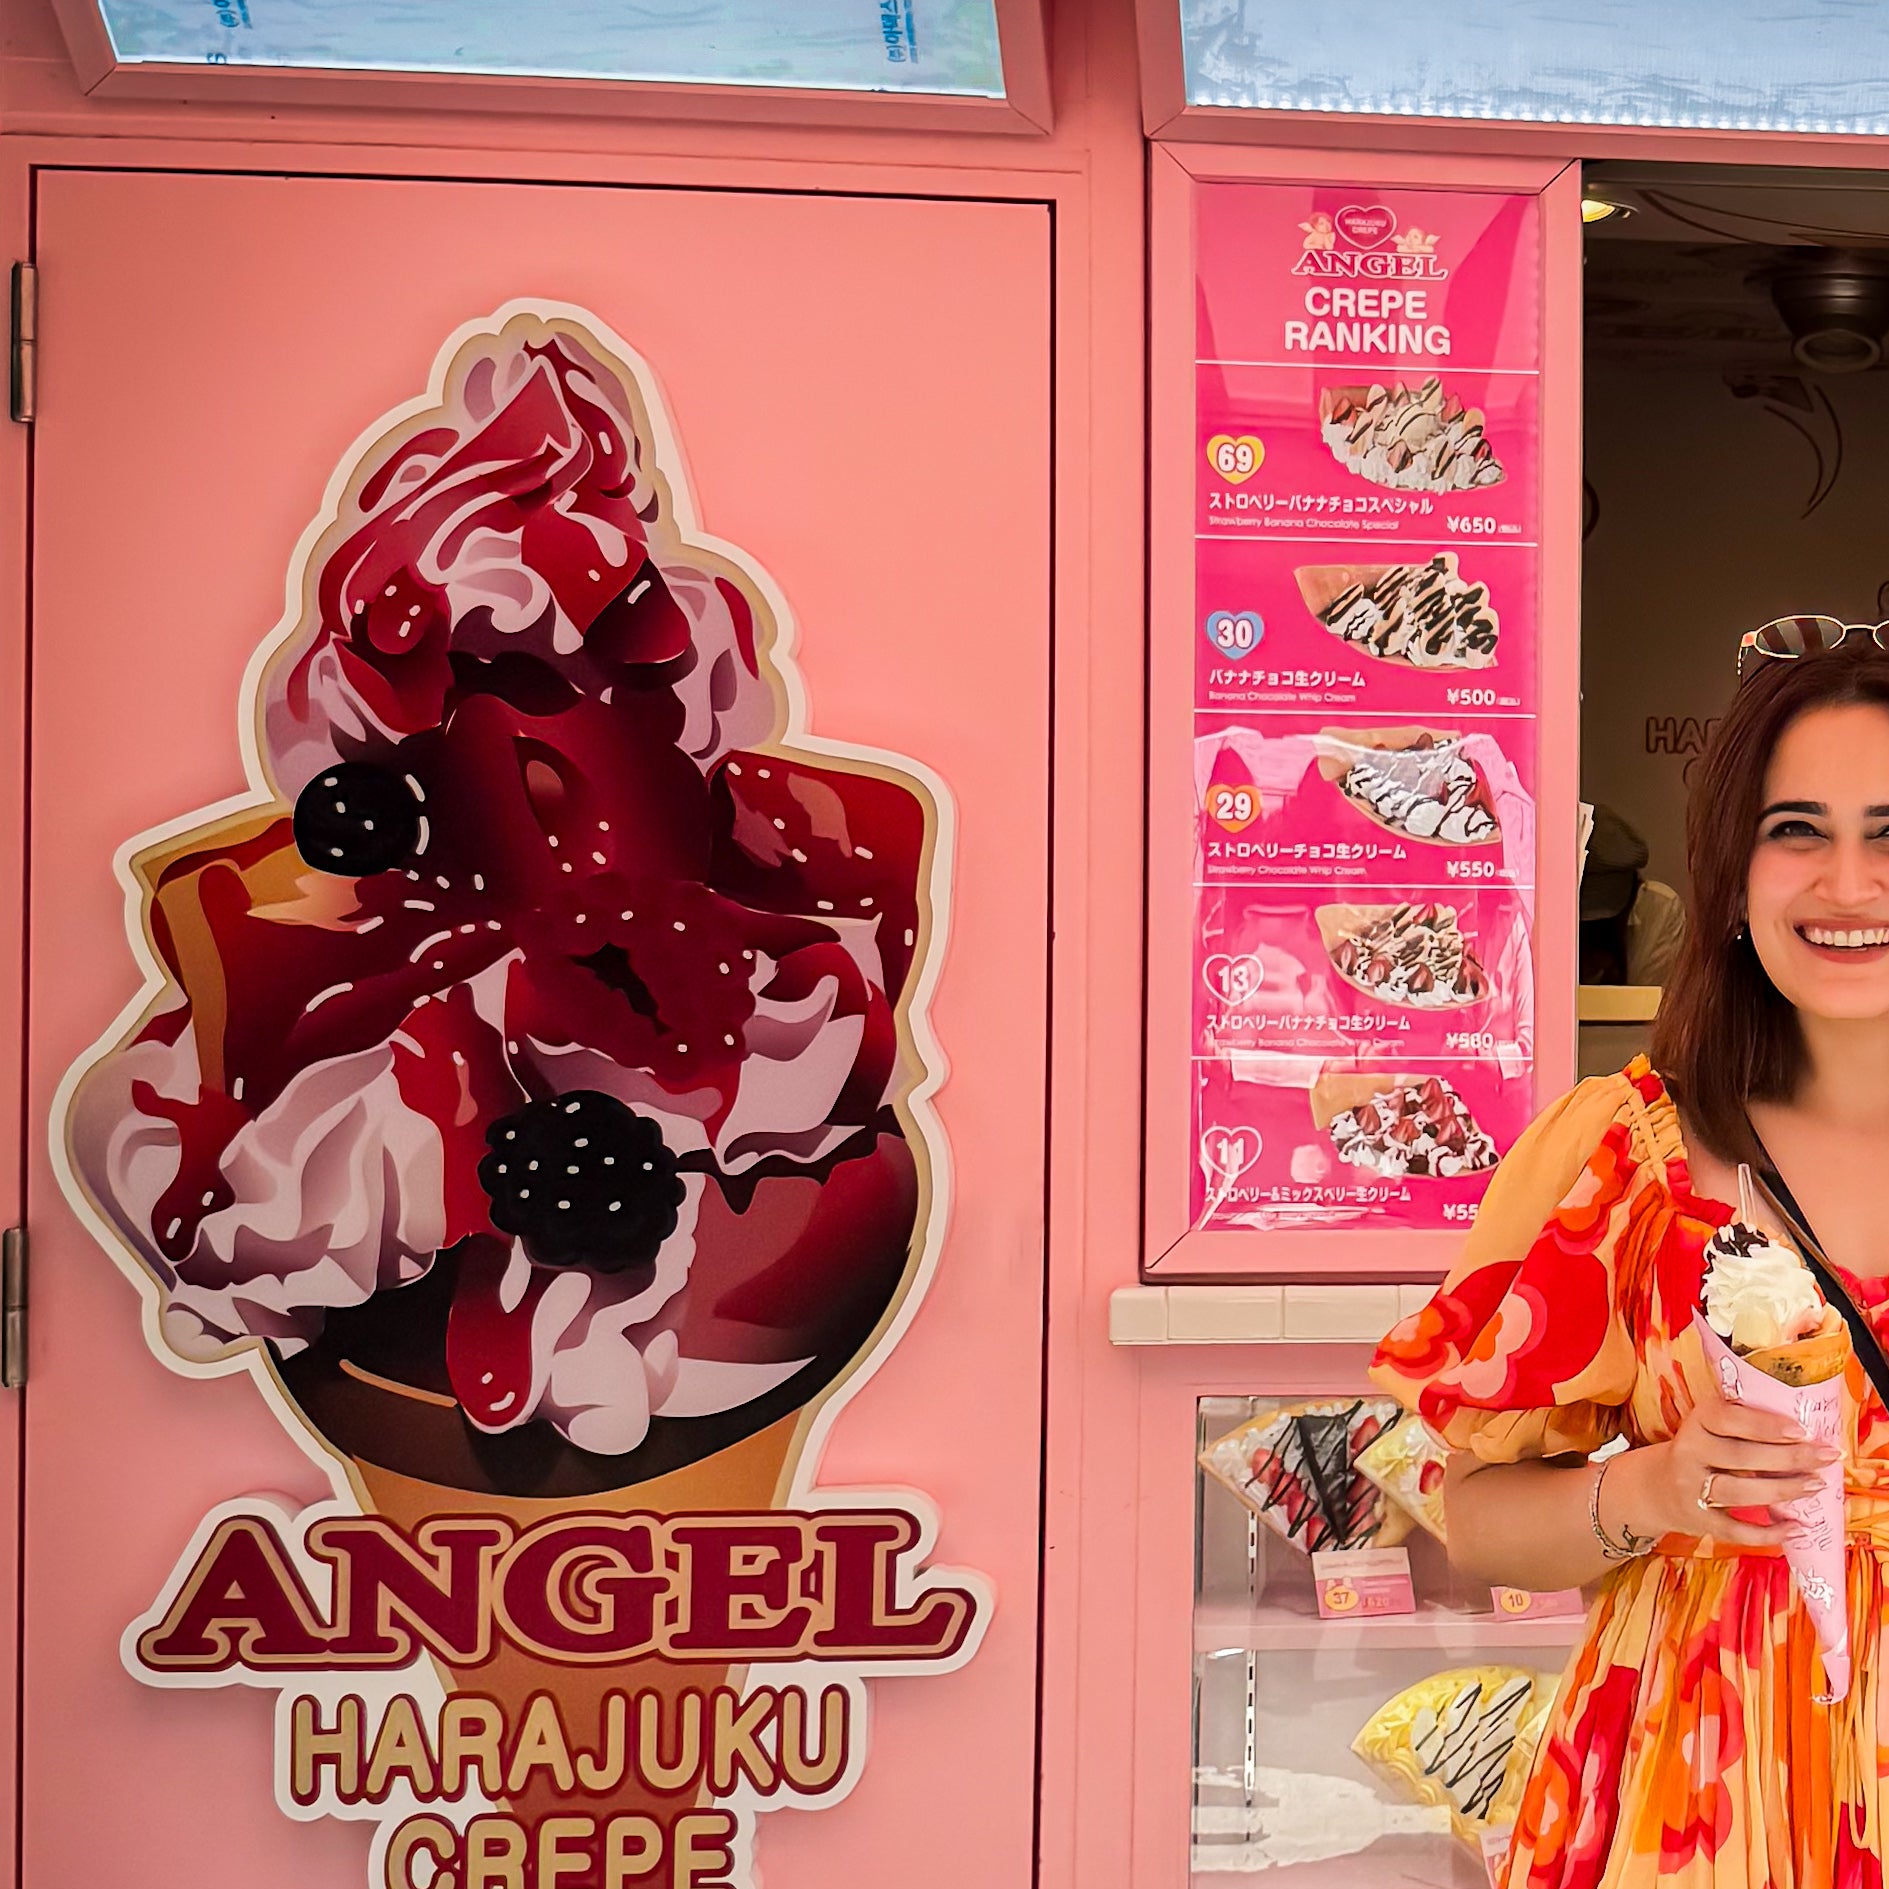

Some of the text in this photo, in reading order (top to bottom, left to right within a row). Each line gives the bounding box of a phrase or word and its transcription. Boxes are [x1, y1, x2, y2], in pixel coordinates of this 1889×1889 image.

[1291, 249, 1448, 280] ANGEL
[1305, 286, 1427, 319] CREPE
[1284, 321, 1451, 355] RANKING
[1217, 442, 1254, 474] 69
[1208, 491, 1434, 516] ストロベリーバナナチョコスペシャル
[1263, 517, 1304, 528] Banana
[1306, 518, 1360, 529] Chocolate
[1446, 515, 1496, 533] ¥650
[1217, 618, 1254, 649] 30
[1208, 668, 1366, 687] バナナチョコ生クリーム
[1446, 688, 1496, 706] ¥500
[1216, 790, 1253, 822] 29
[1207, 841, 1407, 859] ストロベリーチョコ生クリーム
[1446, 860, 1495, 878] ¥550
[1217, 964, 1251, 993] 13
[1446, 1032, 1494, 1049] ¥580
[1442, 1203, 1479, 1221] ¥55
[136, 1508, 981, 1672] ANGEL
[1332, 1591, 1350, 1604] 37
[1508, 1593, 1523, 1607] 10
[289, 1684, 852, 1806] HARAJUKU
